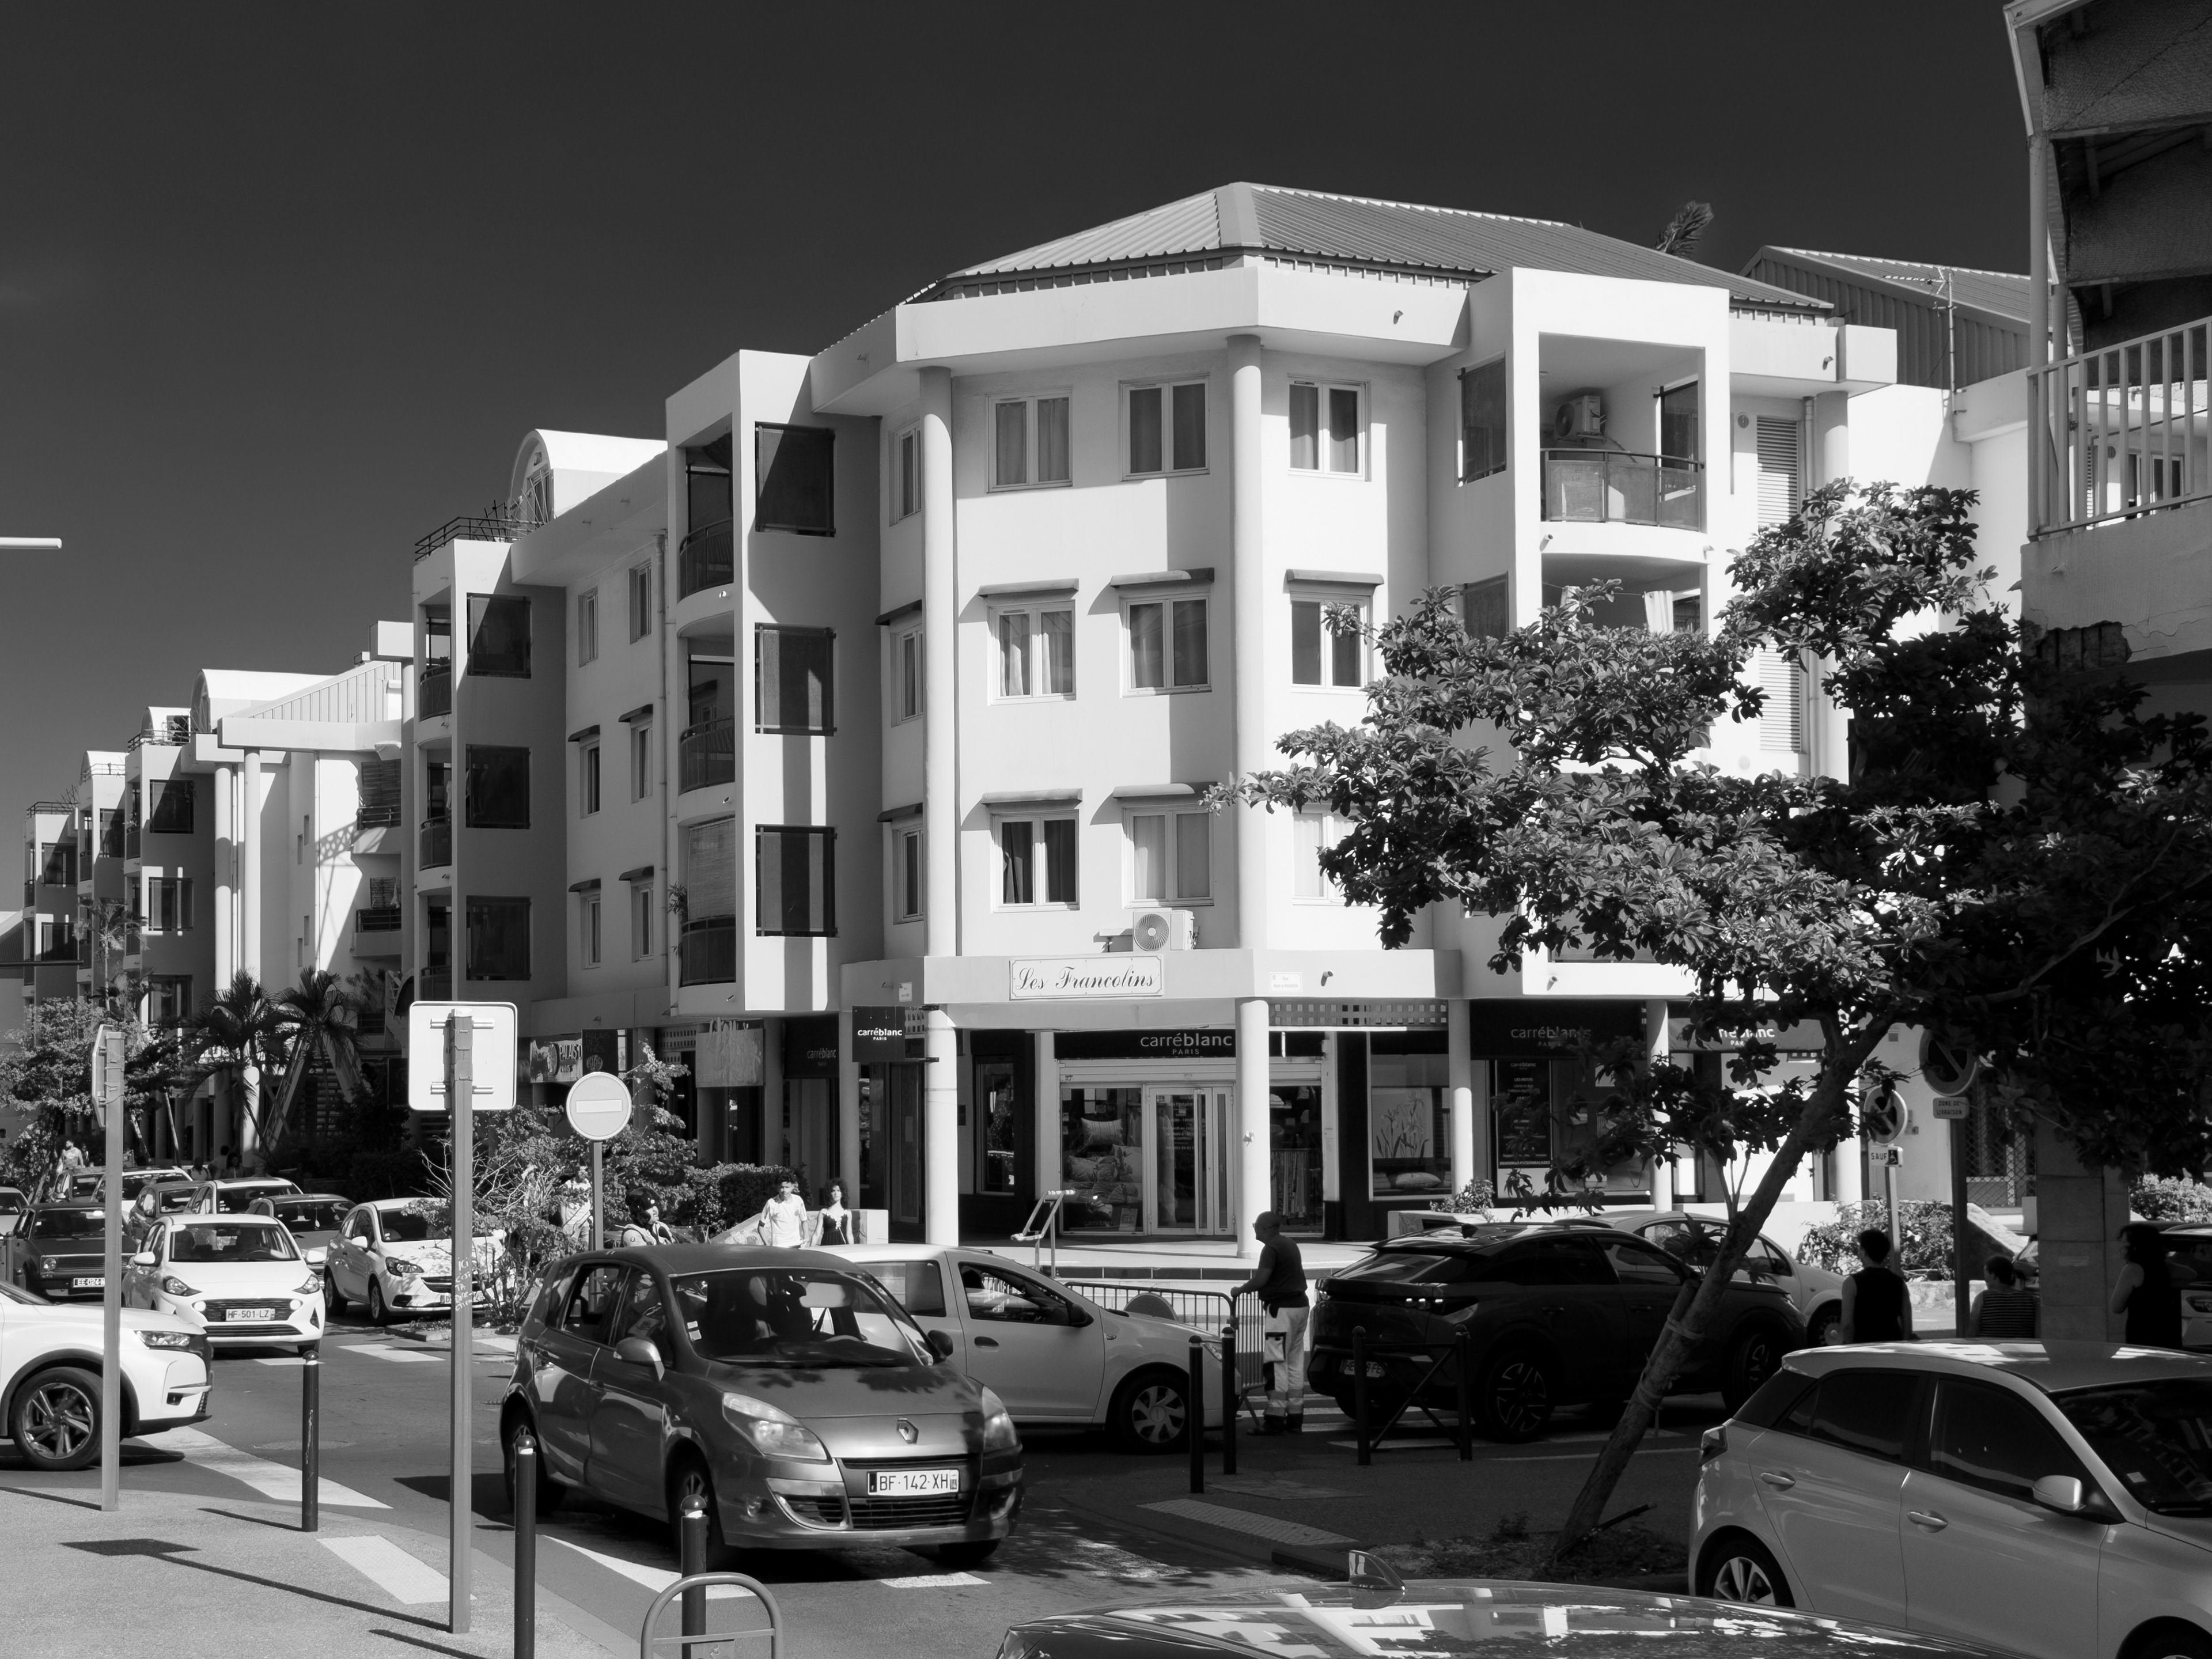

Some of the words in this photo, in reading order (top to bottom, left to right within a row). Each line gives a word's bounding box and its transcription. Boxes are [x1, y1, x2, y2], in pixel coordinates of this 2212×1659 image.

[1016, 967, 1048, 990] Les
[1055, 965, 1158, 989] Francolins
[857, 1028, 902, 1036] carréblanc
[1511, 1027, 1588, 1038] carréblan
[1141, 1033, 1232, 1047] carréblanc
[559, 1044, 577, 1060] PALAIS
[807, 1048, 836, 1059] carréblanc
[228, 1310, 269, 1318] HF-501-LZ
[880, 1474, 948, 1491] BF-142-XH
